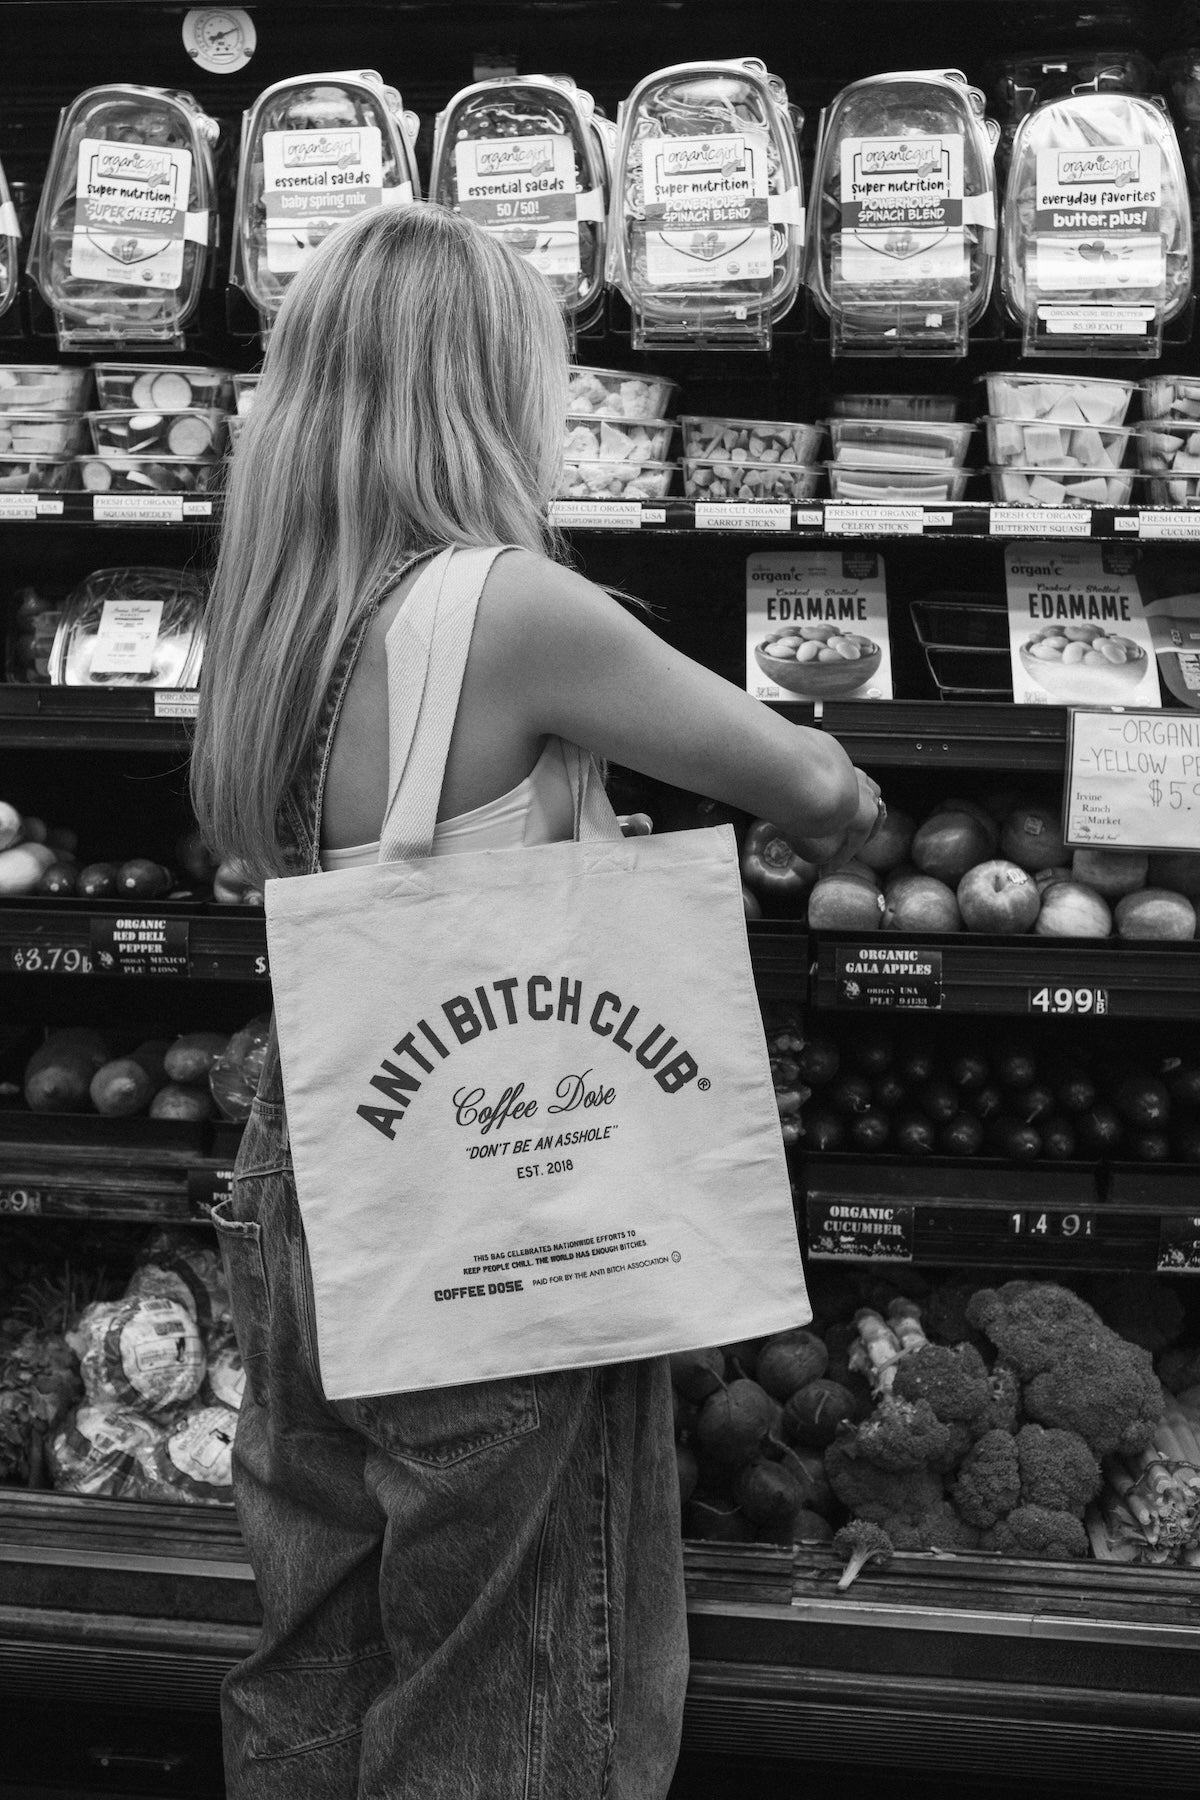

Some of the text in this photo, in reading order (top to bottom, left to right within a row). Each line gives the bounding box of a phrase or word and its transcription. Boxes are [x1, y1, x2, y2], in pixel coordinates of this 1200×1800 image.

[275, 171, 371, 187] essential salads
[468, 178, 565, 196] essential salads
[655, 179, 749, 197] super nutrition
[852, 178, 944, 196] super nutrition
[87, 184, 171, 202] super nutrition
[1042, 191, 1156, 206] everyday favorites
[281, 192, 367, 210] baby spring mix
[665, 195, 746, 211] POWERHOUSE
[861, 196, 941, 211] POWERHOUSE
[662, 208, 751, 222] SPINACH BLEND
[857, 207, 946, 222] SPINACH BLEND
[1109, 211, 1148, 228] plus!
[1050, 310, 1080, 318] ORGANIC
[1099, 310, 1114, 318] RED
[1097, 323, 1124, 332] EACH
[41, 504, 57, 512] USA
[187, 505, 206, 513] MEX
[551, 504, 639, 513] RESH CUT ORGANIC
[697, 506, 728, 514] FRESH
[748, 507, 788, 515] ORGANIC
[828, 509, 921, 518] FRESH CUT ORGANIC
[103, 510, 137, 518] SQUASH
[644, 512, 662, 520] USA
[801, 515, 819, 523] USA
[927, 515, 946, 523] USA
[994, 511, 1025, 519] FRESH
[1046, 512, 1086, 520] ORGANIC
[1141, 515, 1171, 523] FRESH
[555, 517, 602, 525] CAULIFLOWER
[707, 519, 776, 528] CARROT STICKS
[841, 522, 909, 531] CELERY STICKS
[1118, 520, 1137, 528] USA
[994, 524, 1087, 534] BUTTERNUT SQUASH
[752, 567, 802, 583] organic
[767, 597, 868, 621] EDAMAME
[1028, 593, 1132, 621] EDAMAME
[1076, 792, 1103, 801] Irvine
[1082, 803, 1111, 813] Ranch
[1087, 816, 1122, 826] Market
[116, 919, 167, 930] ORGANIC
[113, 931, 166, 942] RED BELL
[119, 943, 163, 954] PEPPER
[149, 956, 187, 965] MEXICO
[859, 949, 919, 961] ORGANIC
[123, 966, 146, 974] PLU
[845, 962, 932, 975] GALA APPLES
[900, 986, 919, 995] USA
[869, 997, 894, 1006] PLU
[1032, 987, 1094, 1013] 4.99
[356, 1019, 451, 1141] ANTI
[441, 975, 583, 1045] BITCH
[452, 1068, 617, 1135] Coffee Dose
[512, 1139, 532, 1154] BE
[534, 1135, 554, 1151] AN
[517, 1159, 574, 1179] EST. 2018
[829, 1205, 894, 1221] ORGANIC
[823, 1220, 903, 1236] CUCUMBER
[473, 1230, 636, 1263] THIS BAG CELEBRATES NATIONWIDE EFFORTS TO
[463, 1267, 481, 1276] KEEP
[482, 1262, 510, 1273] PEOPLE
[535, 1255, 549, 1265] THE
[550, 1252, 575, 1262] WORLD
[575, 1250, 590, 1259] HAS
[591, 1245, 619, 1256] ENOUGH
[532, 1256, 669, 1286] PAID FOR BY THE ANTI BITCH ASSOCIATION
[434, 1280, 524, 1302] COFFEE DOSE
